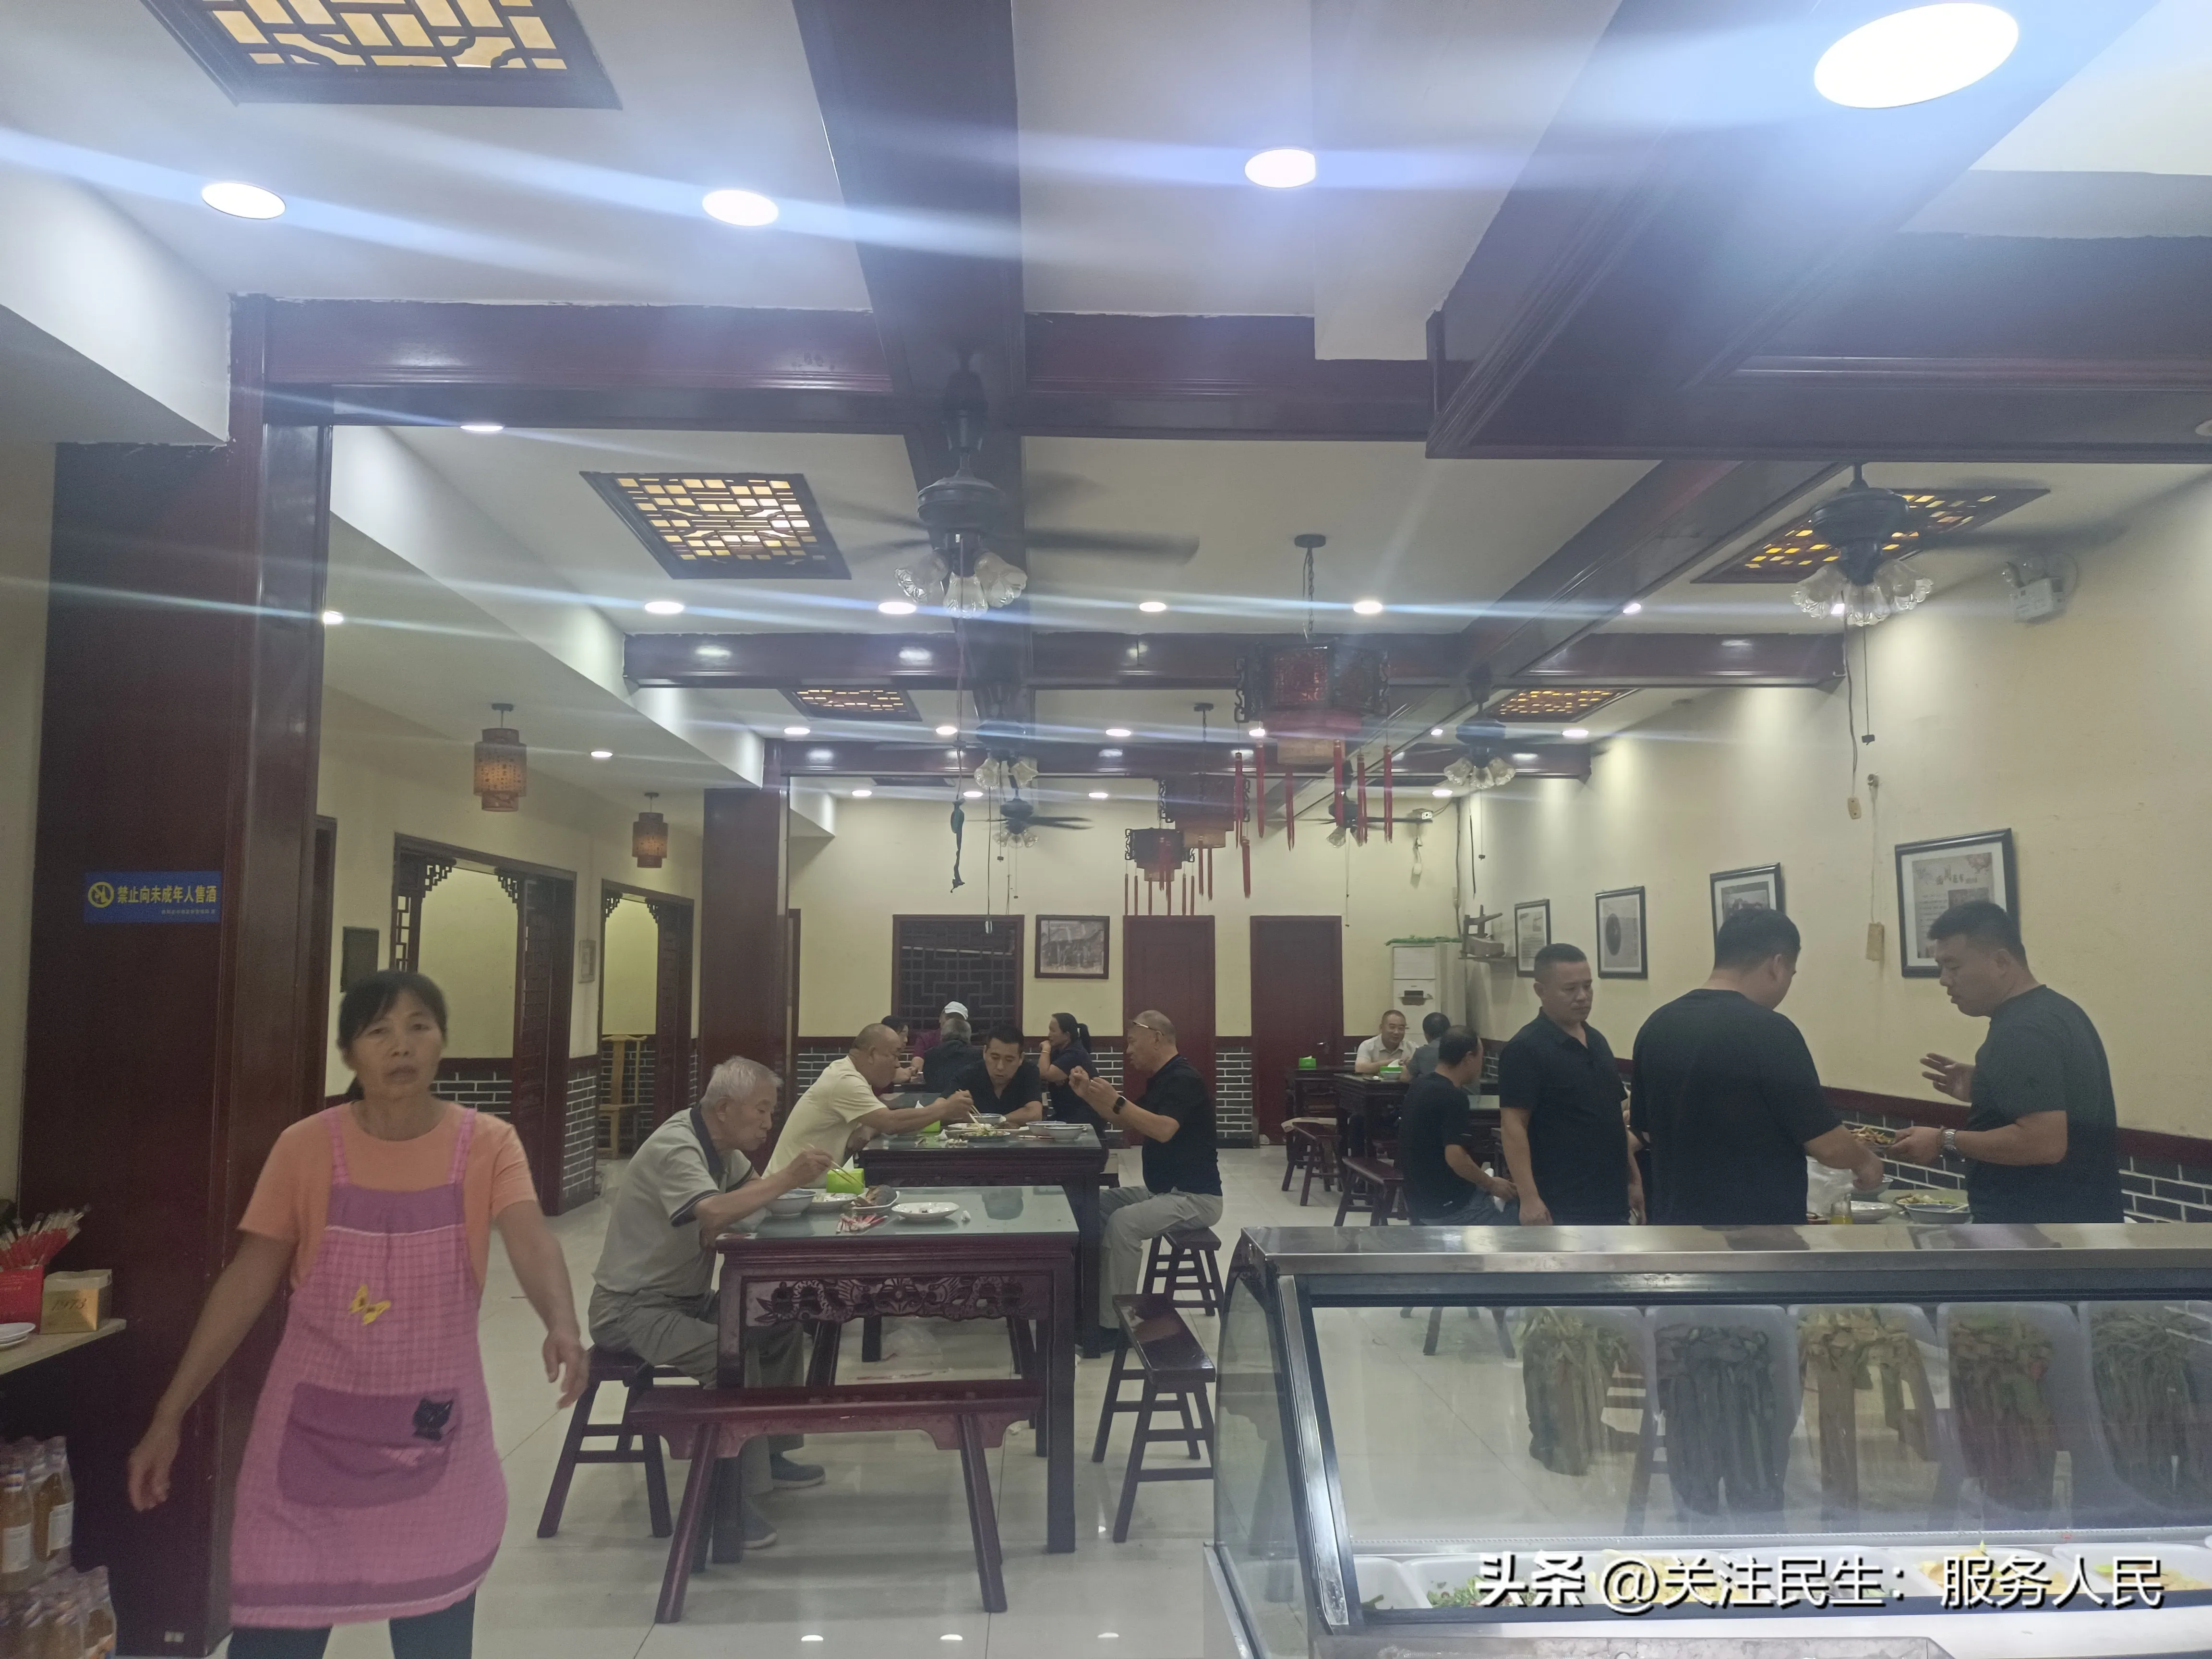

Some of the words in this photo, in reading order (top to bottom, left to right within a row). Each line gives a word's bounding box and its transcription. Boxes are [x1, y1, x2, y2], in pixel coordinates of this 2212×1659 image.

[117, 885, 216, 903] 禁止向未成年人售酒
